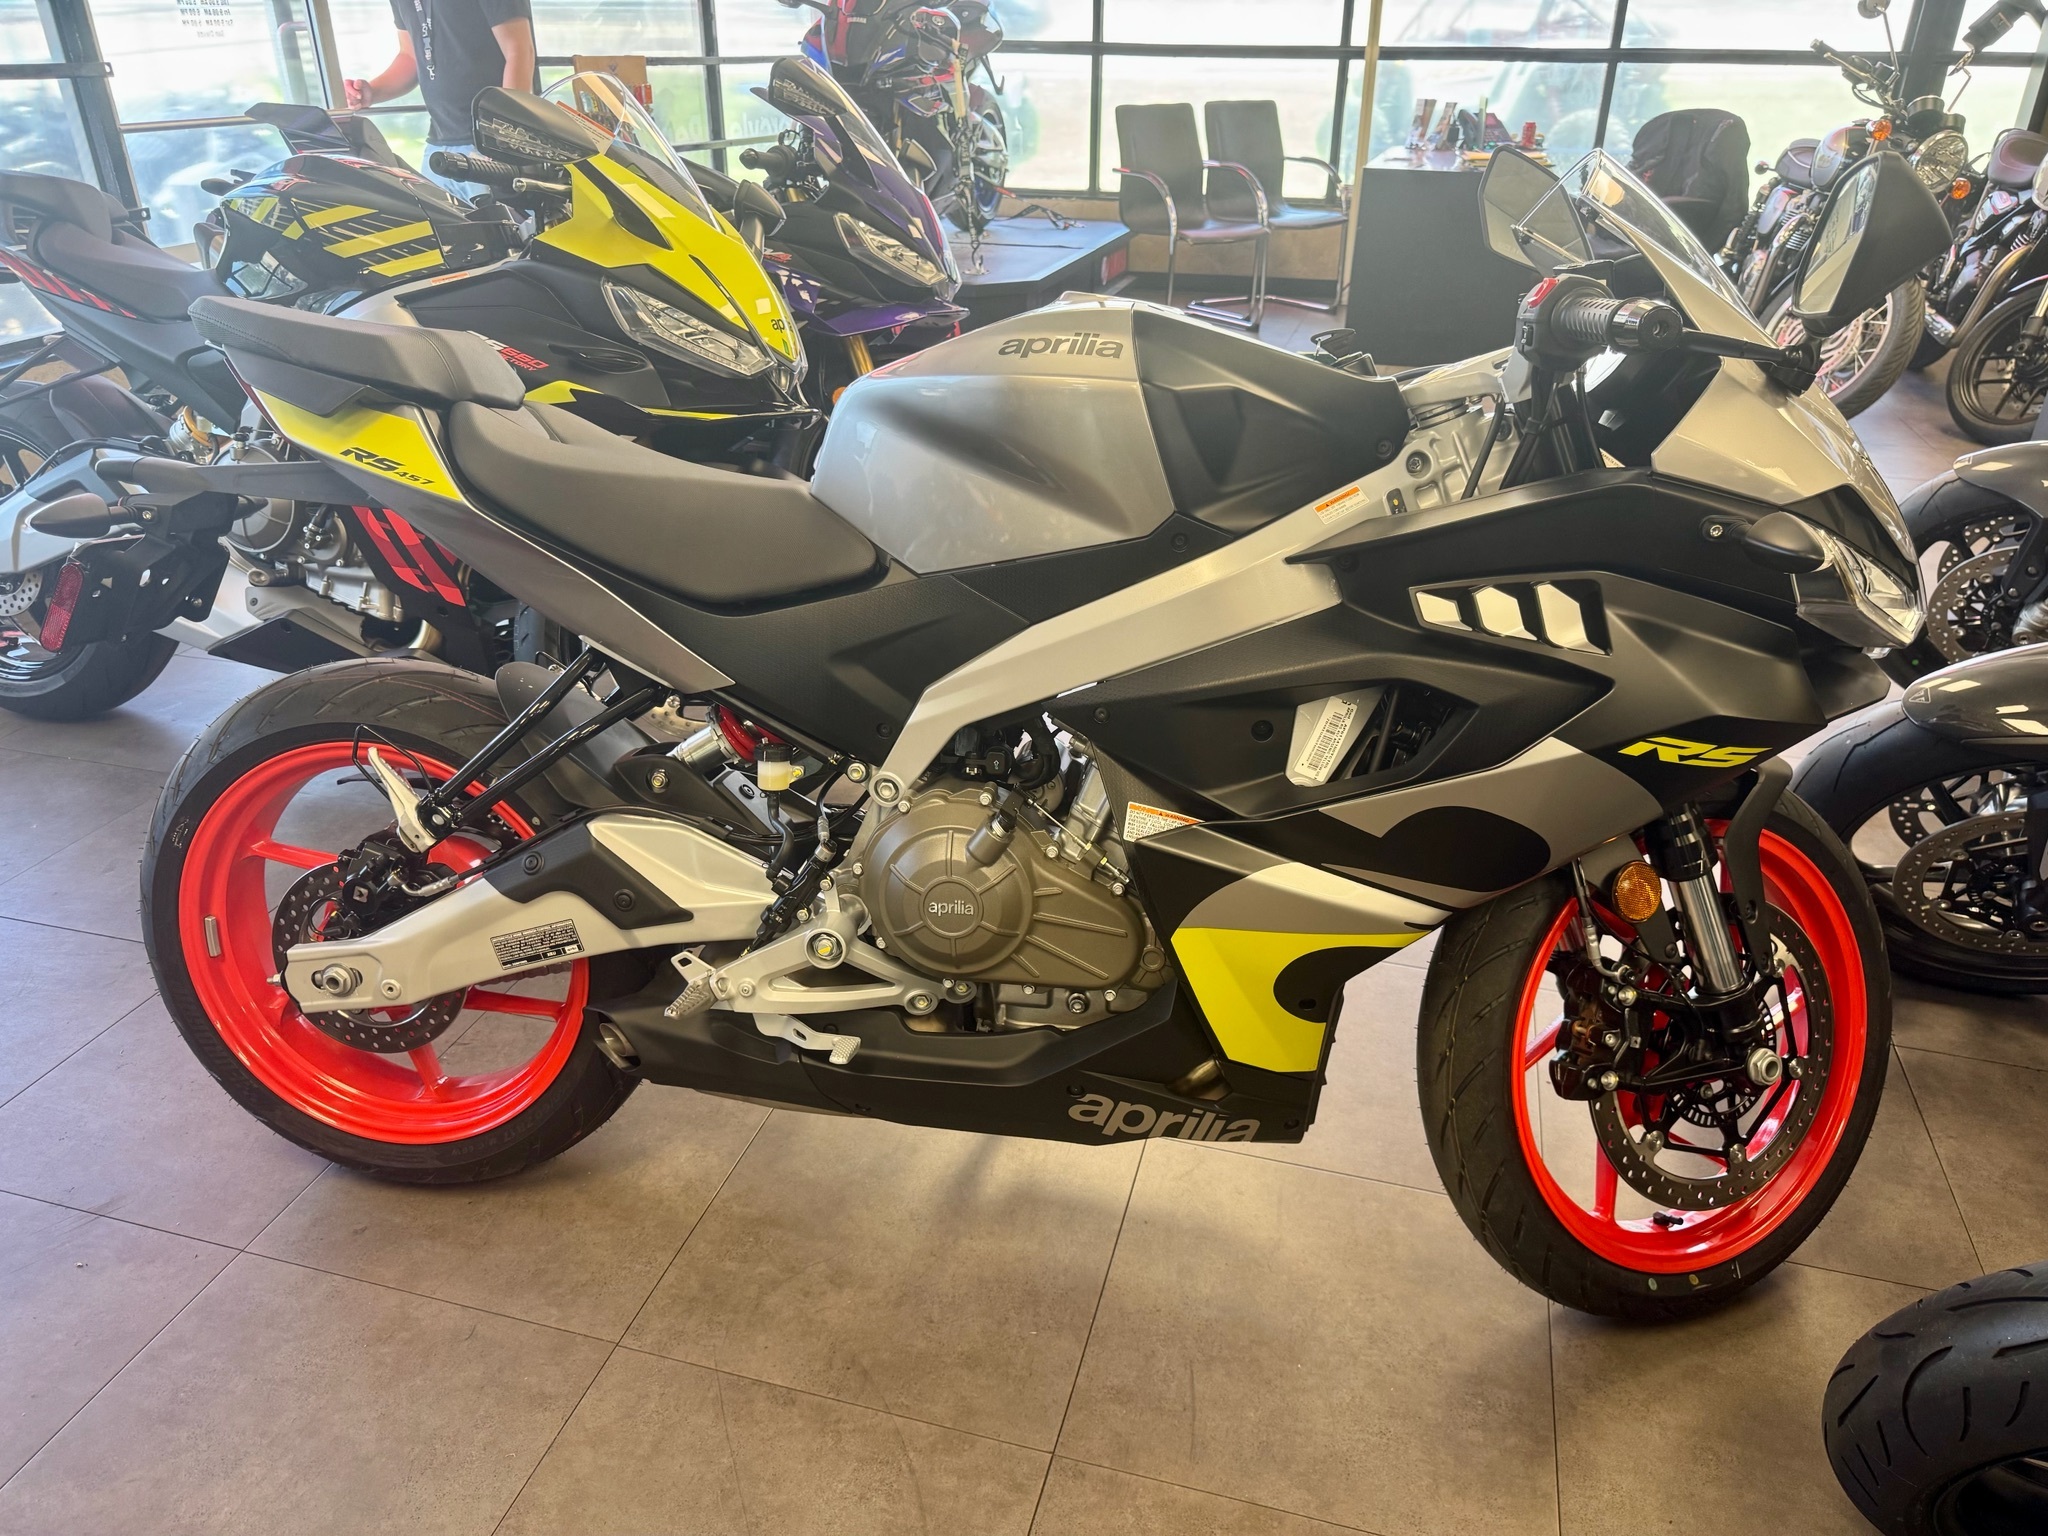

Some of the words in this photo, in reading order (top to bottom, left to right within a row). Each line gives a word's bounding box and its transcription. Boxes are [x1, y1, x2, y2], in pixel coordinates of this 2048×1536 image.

[1008, 332, 1124, 358] aprilia
[340, 447, 406, 472] RS
[393, 472, 435, 485] 457
[1617, 737, 1770, 767] RS
[928, 900, 973, 916] aprilia
[1068, 1093, 1260, 1142] aprilia
